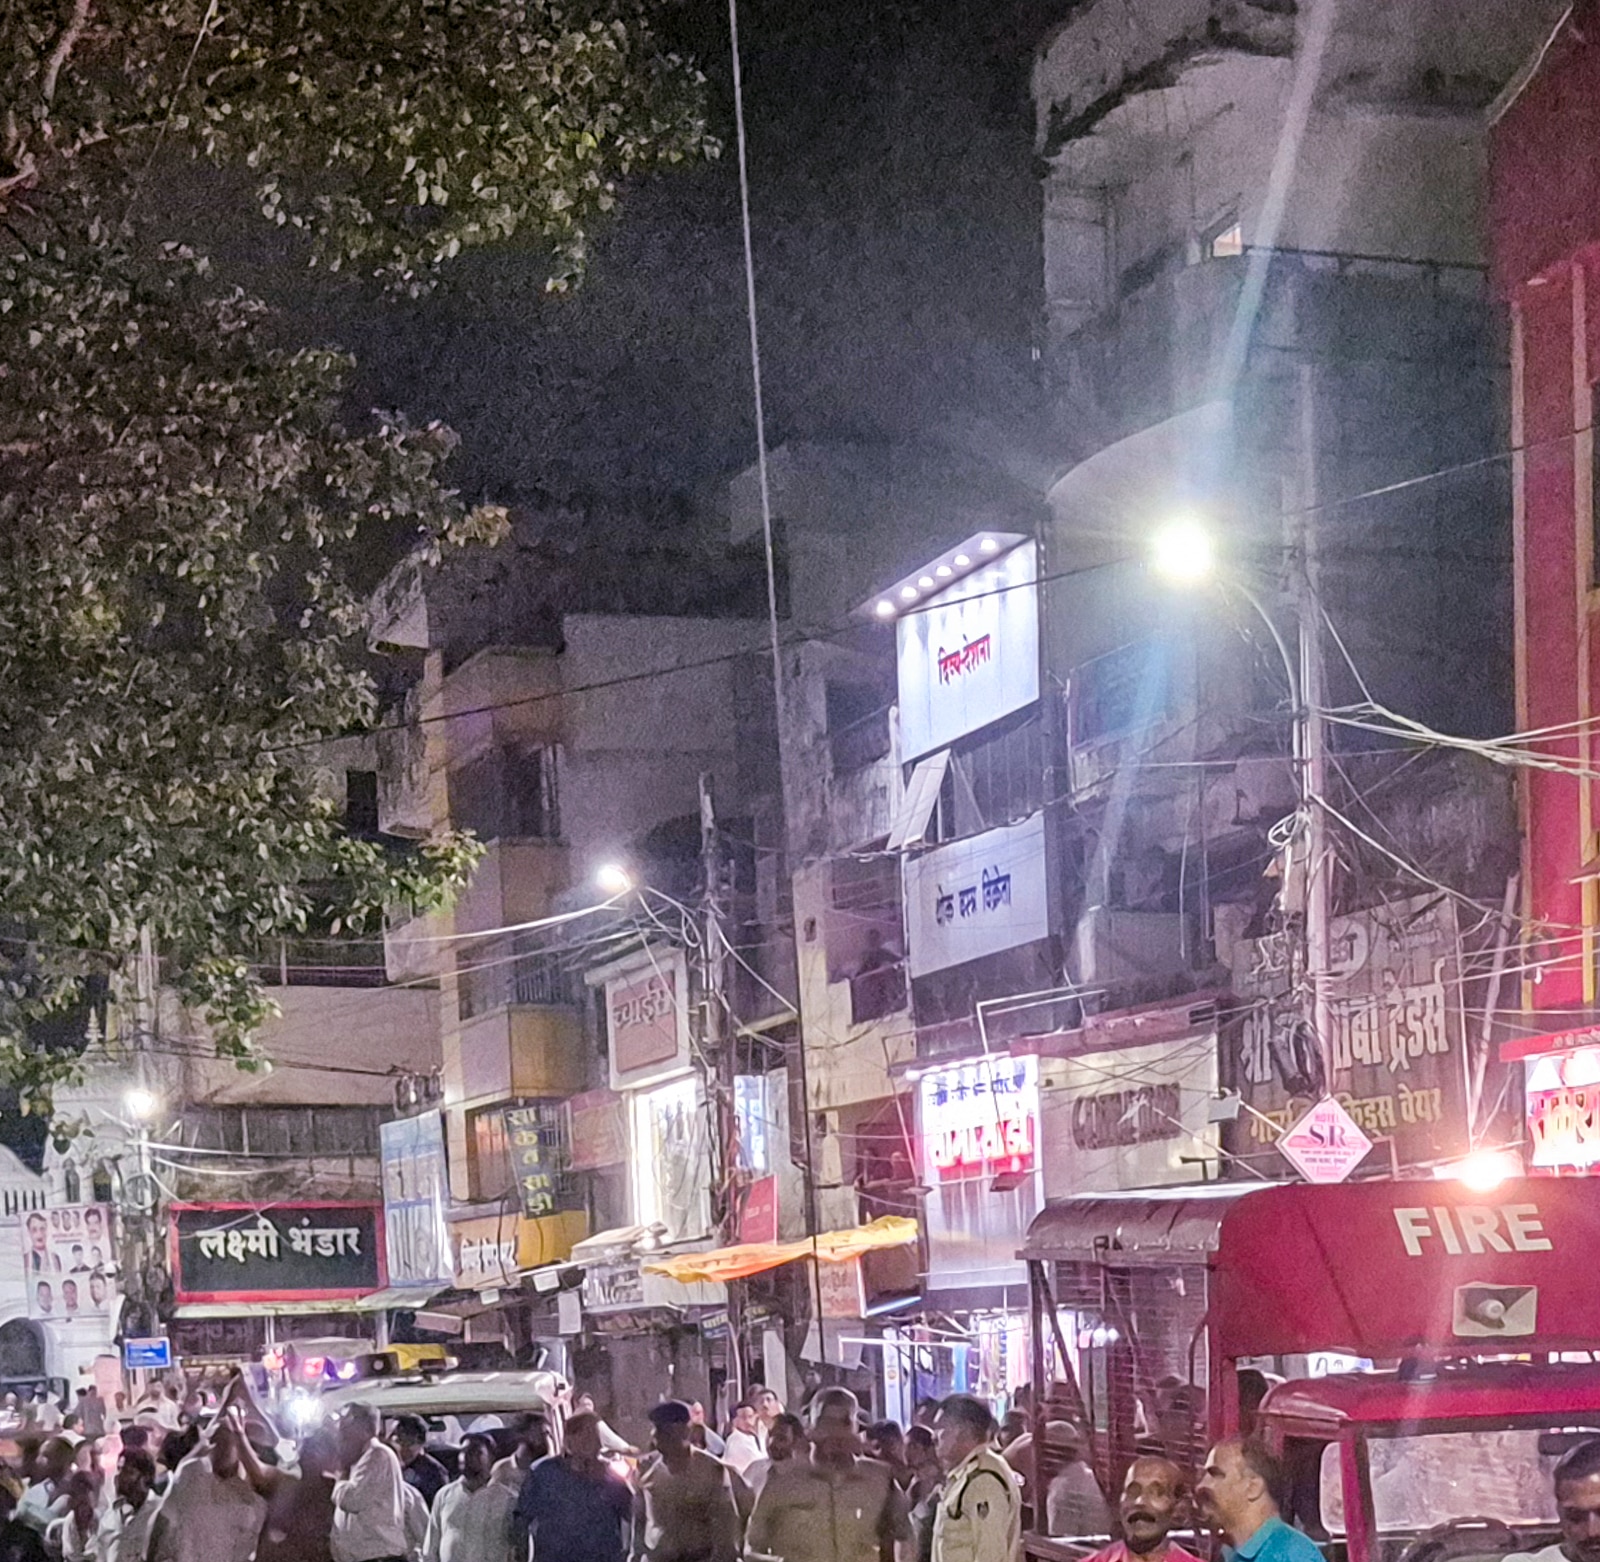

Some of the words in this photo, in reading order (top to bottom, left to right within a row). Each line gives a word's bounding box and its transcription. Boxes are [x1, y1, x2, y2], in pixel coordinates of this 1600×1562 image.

[1308, 1124, 1347, 1149] SR
[196, 1216, 279, 1263] लक्ष्मी
[288, 1217, 363, 1257] भंडार
[1393, 1203, 1553, 1256] FIRE
